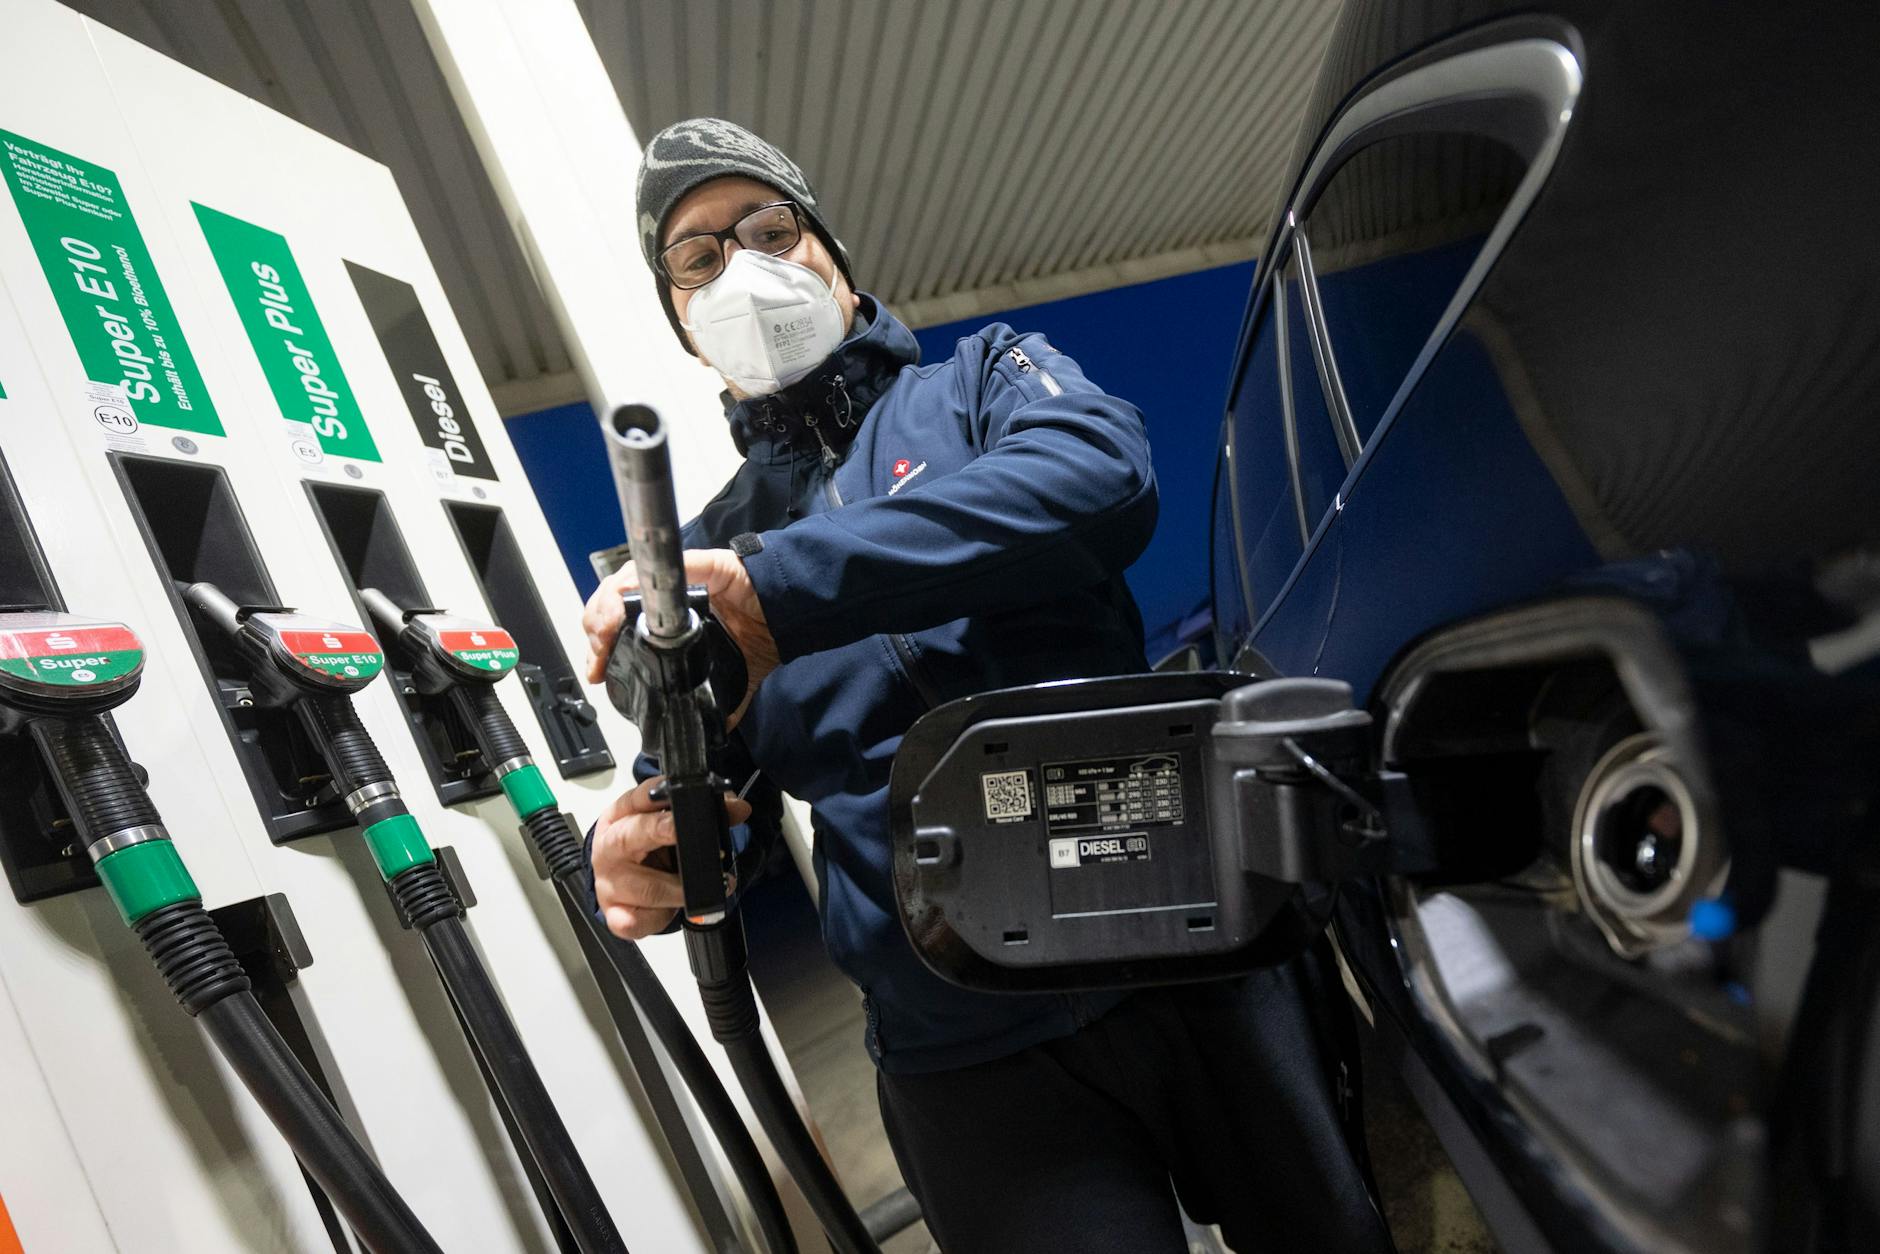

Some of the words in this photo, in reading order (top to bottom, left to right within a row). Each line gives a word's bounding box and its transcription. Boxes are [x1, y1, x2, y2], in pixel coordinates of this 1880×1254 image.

[3, 140, 63, 169] Verträgt
[65, 164, 84, 177] Ihr
[8, 152, 77, 185] Fahrzeug
[79, 178, 112, 195] E10?
[22, 185, 53, 200] Super
[71, 196, 99, 210] Super
[101, 207, 122, 218] oder
[60, 237, 119, 301] E10
[111, 244, 149, 306] Bioethanol
[251, 261, 304, 335] Plus
[139, 309, 160, 331] 10%
[153, 335, 167, 350] zu
[95, 305, 161, 404] Super
[159, 351, 176, 368] bis
[165, 369, 193, 411] Enthält
[283, 339, 348, 440] Super
[98, 412, 133, 427] E10
[412, 373, 475, 464] Diesel
[39, 657, 107, 670] Super
[309, 655, 350, 666] Super
[351, 655, 377, 664] E10
[460, 651, 491, 662] Super
[492, 650, 516, 659] Plus
[1058, 849, 1070, 857] B7
[1080, 840, 1125, 856] DIESEL
